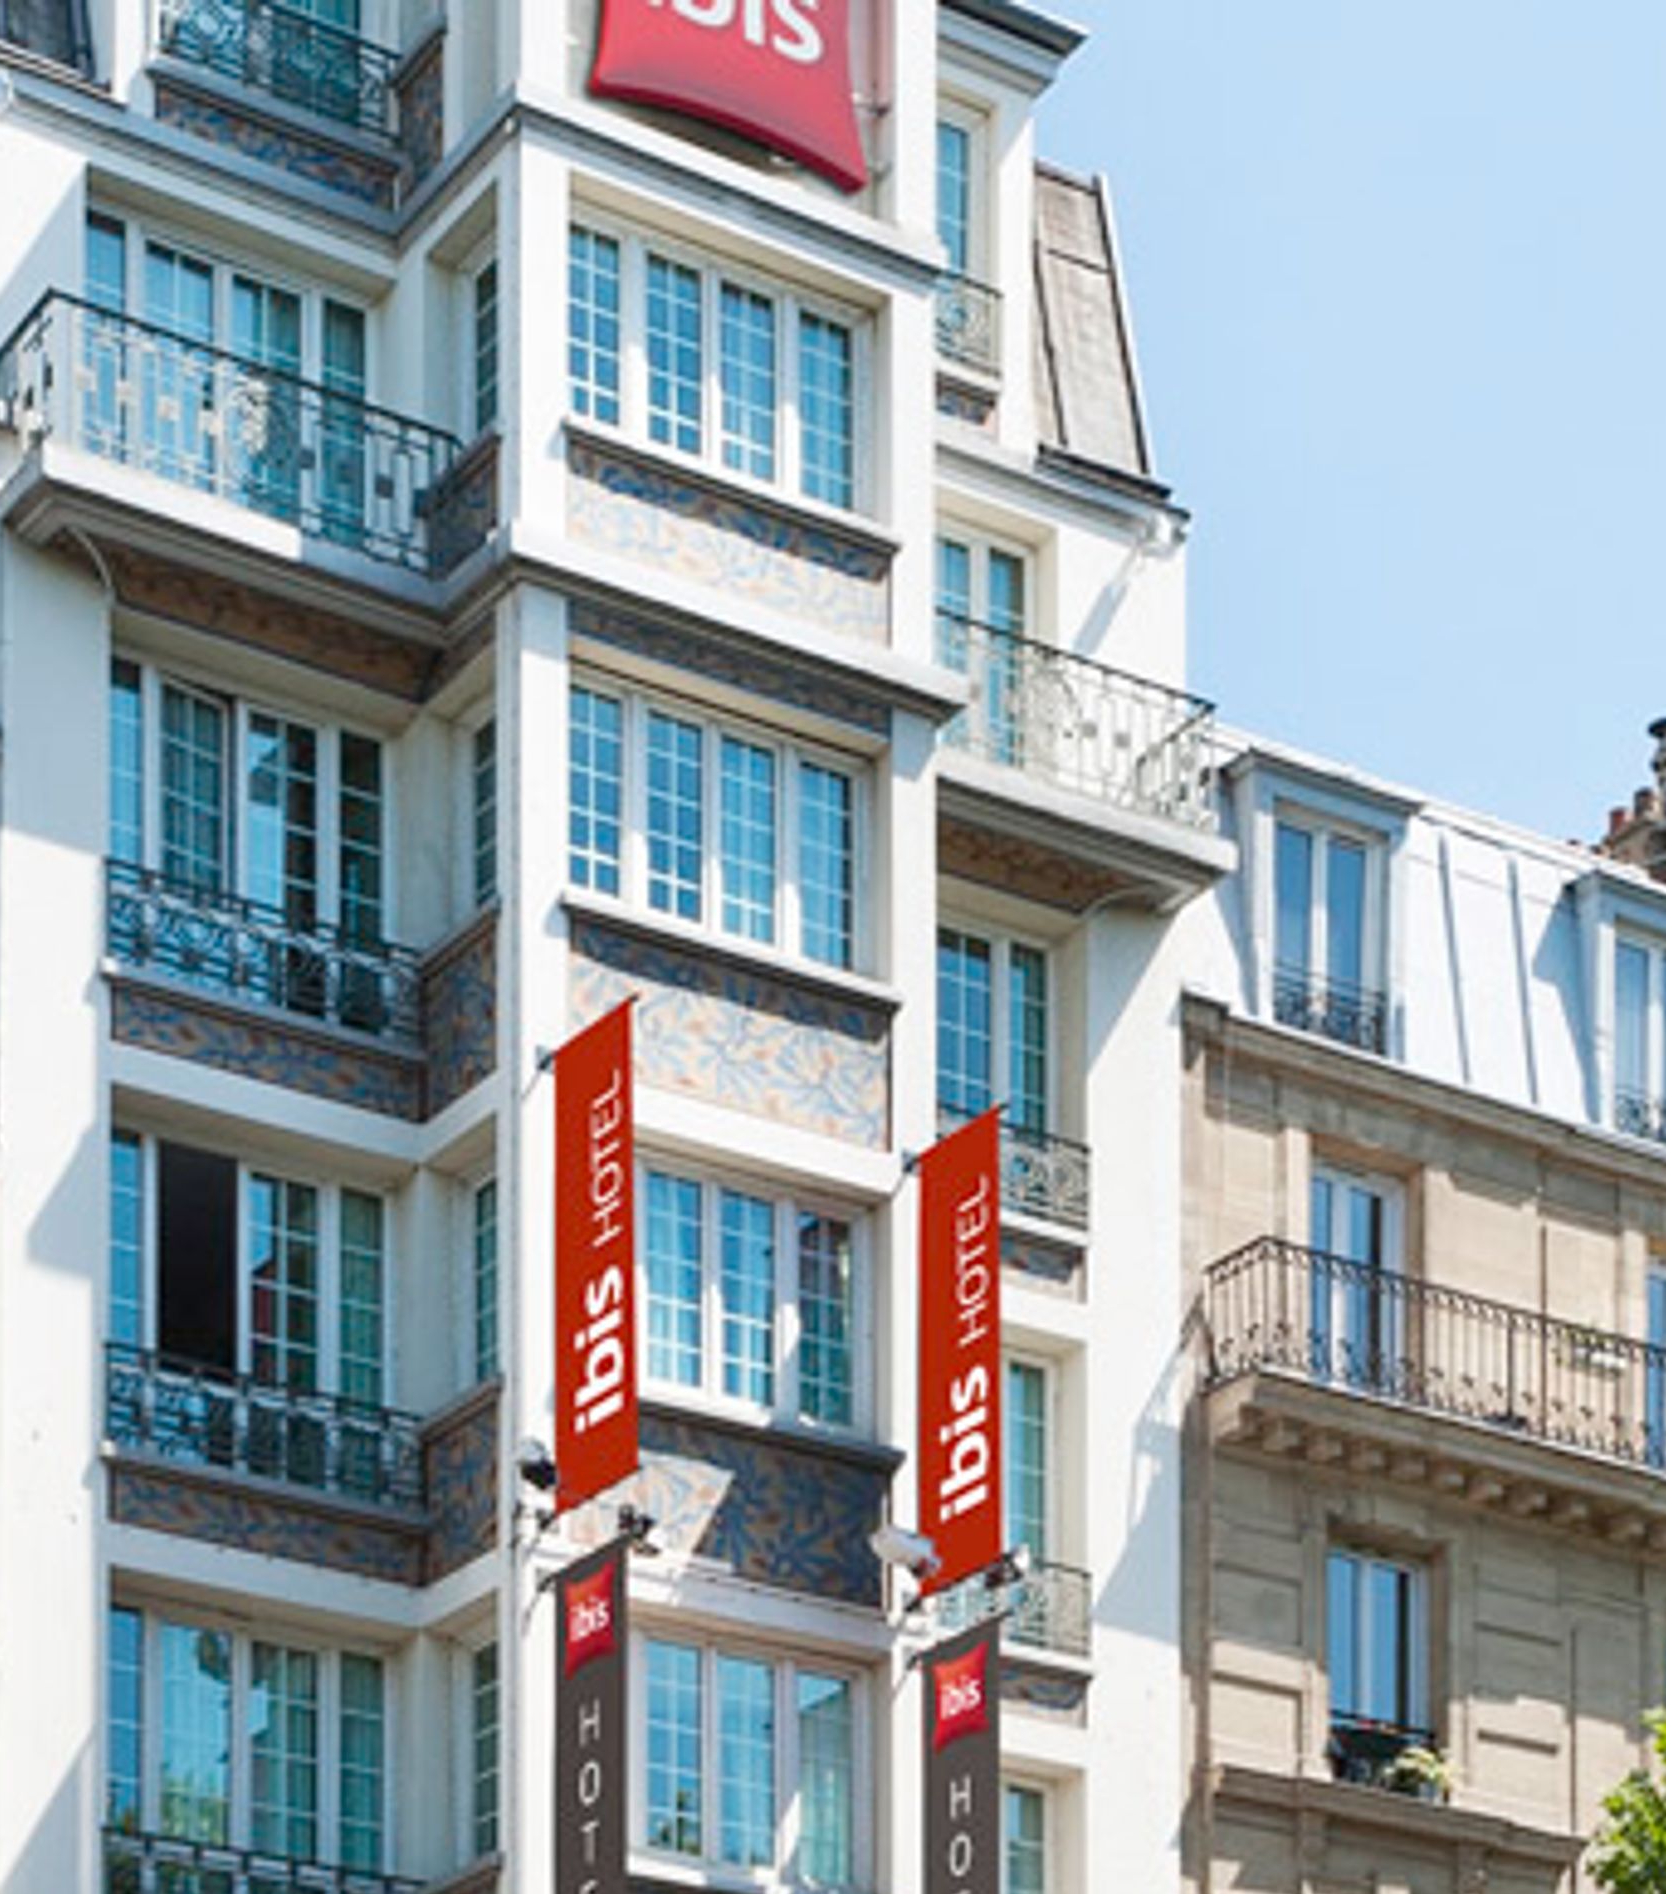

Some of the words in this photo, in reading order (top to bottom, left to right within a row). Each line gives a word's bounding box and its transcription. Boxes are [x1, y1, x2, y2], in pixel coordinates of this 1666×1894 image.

[590, 1069, 622, 1248] HOTEL
[955, 1175, 989, 1348] HOTEL
[574, 1264, 624, 1433] ibis
[940, 1364, 989, 1523] ibis
[569, 1596, 610, 1642] ibis
[940, 1675, 981, 1720] ibis
